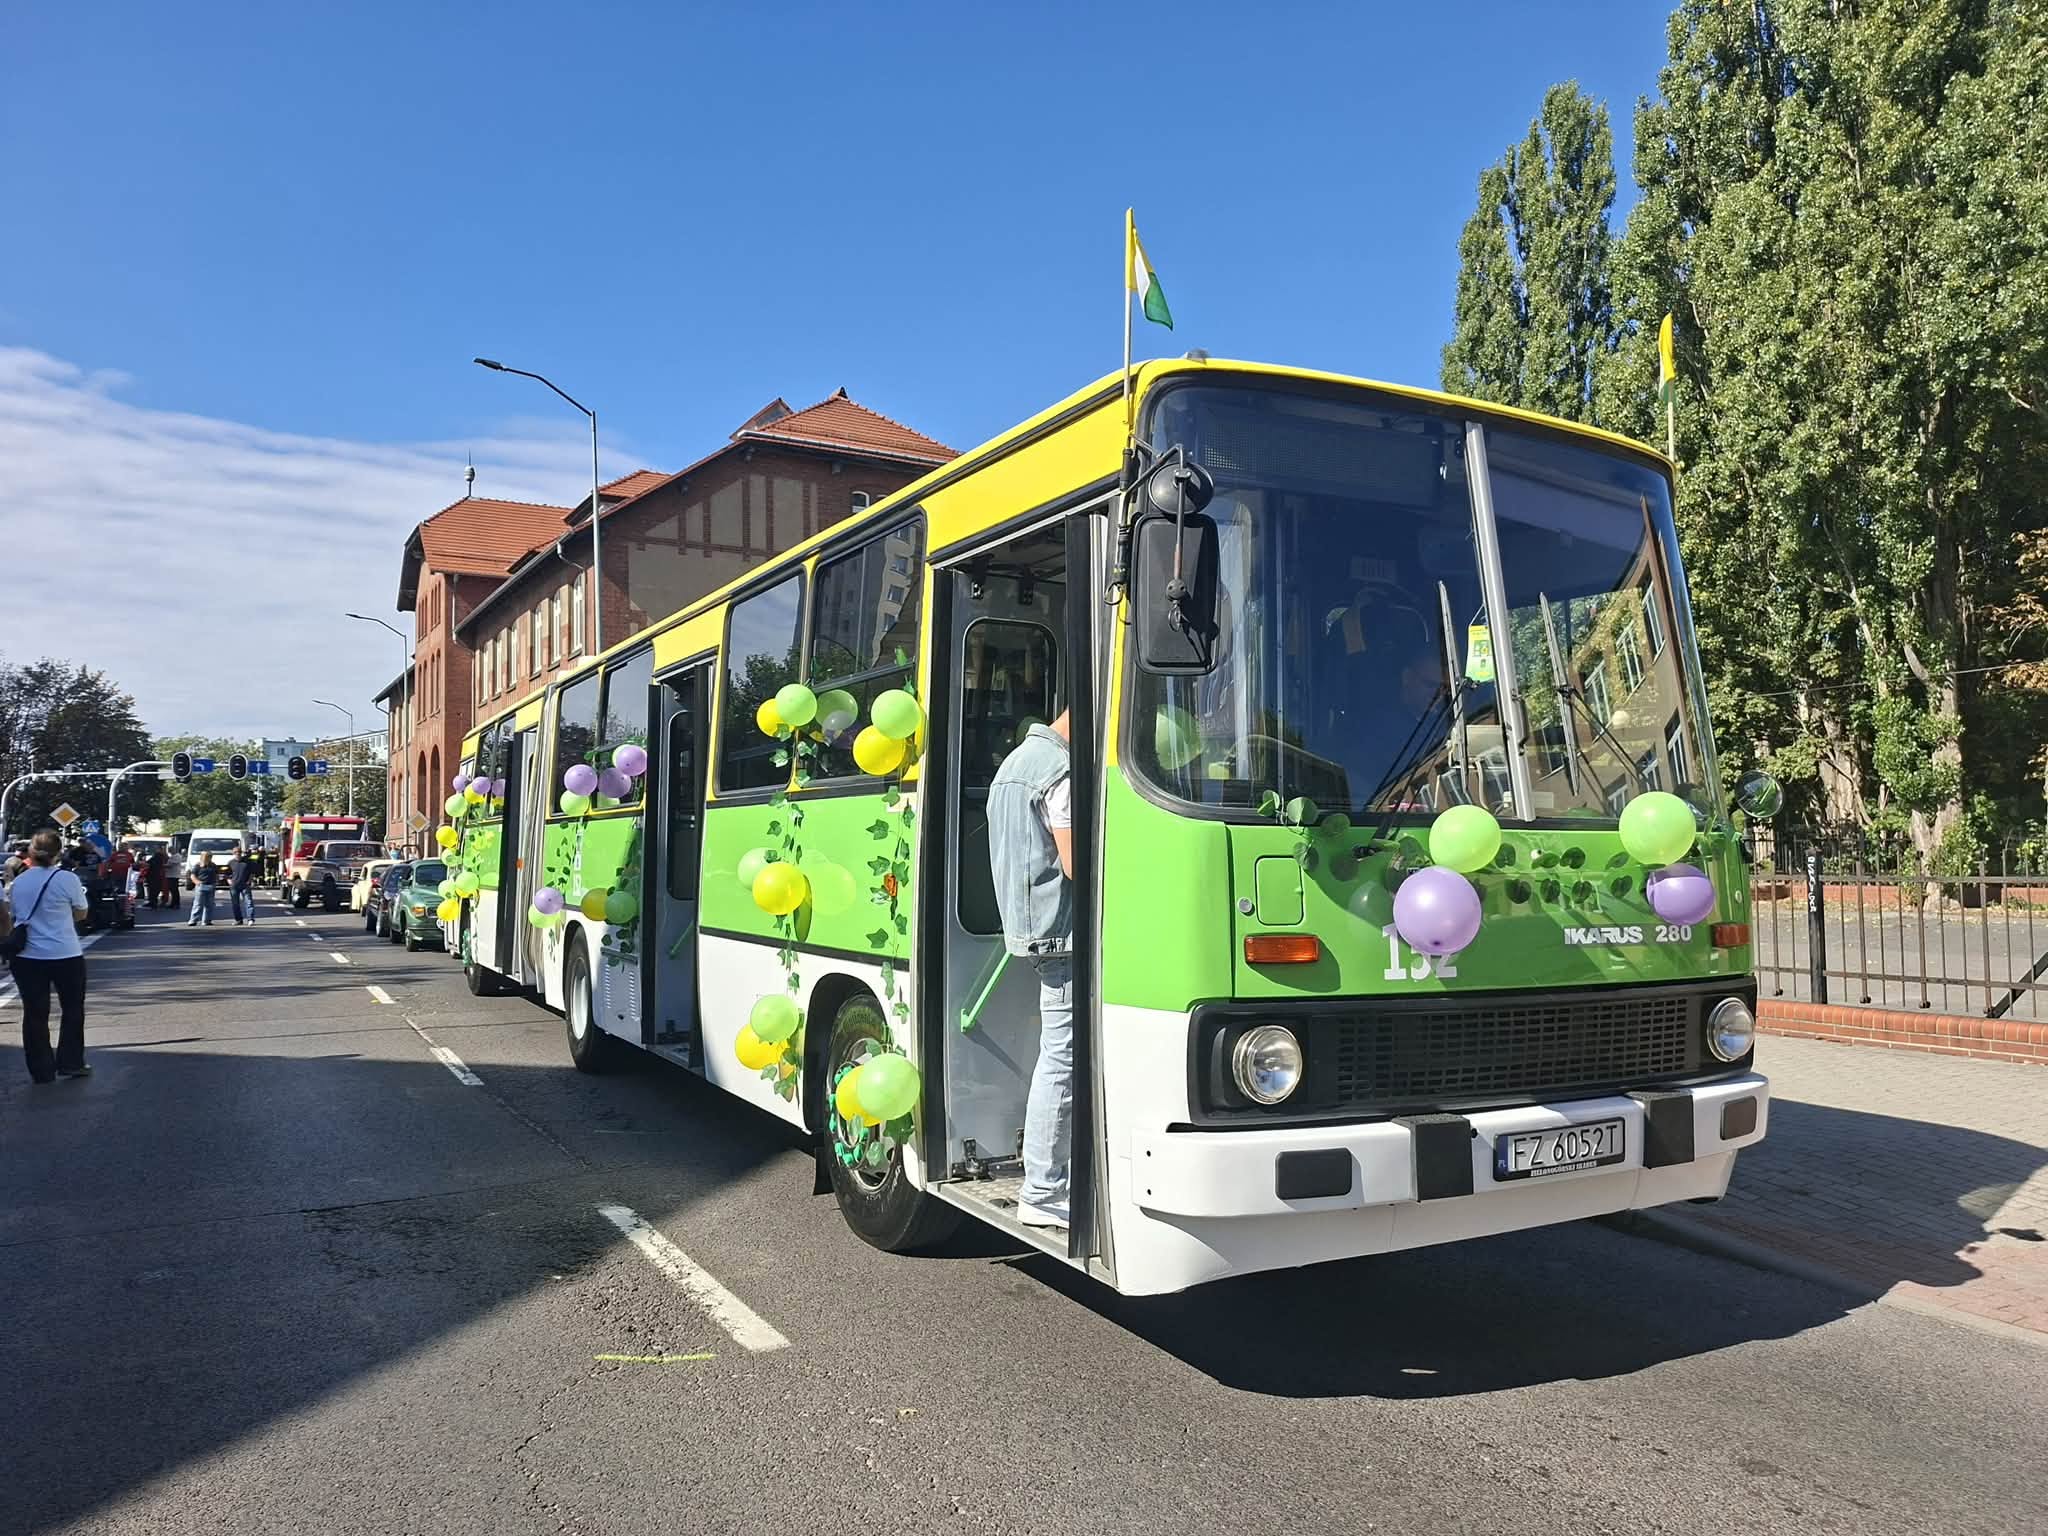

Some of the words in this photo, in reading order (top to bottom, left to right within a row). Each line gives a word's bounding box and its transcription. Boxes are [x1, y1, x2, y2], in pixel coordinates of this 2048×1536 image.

[1564, 926, 1643, 944] IKARUS
[1655, 925, 1692, 942] 280
[1512, 1136, 1544, 1169] FZ
[1552, 1125, 1617, 1161] 6052T
